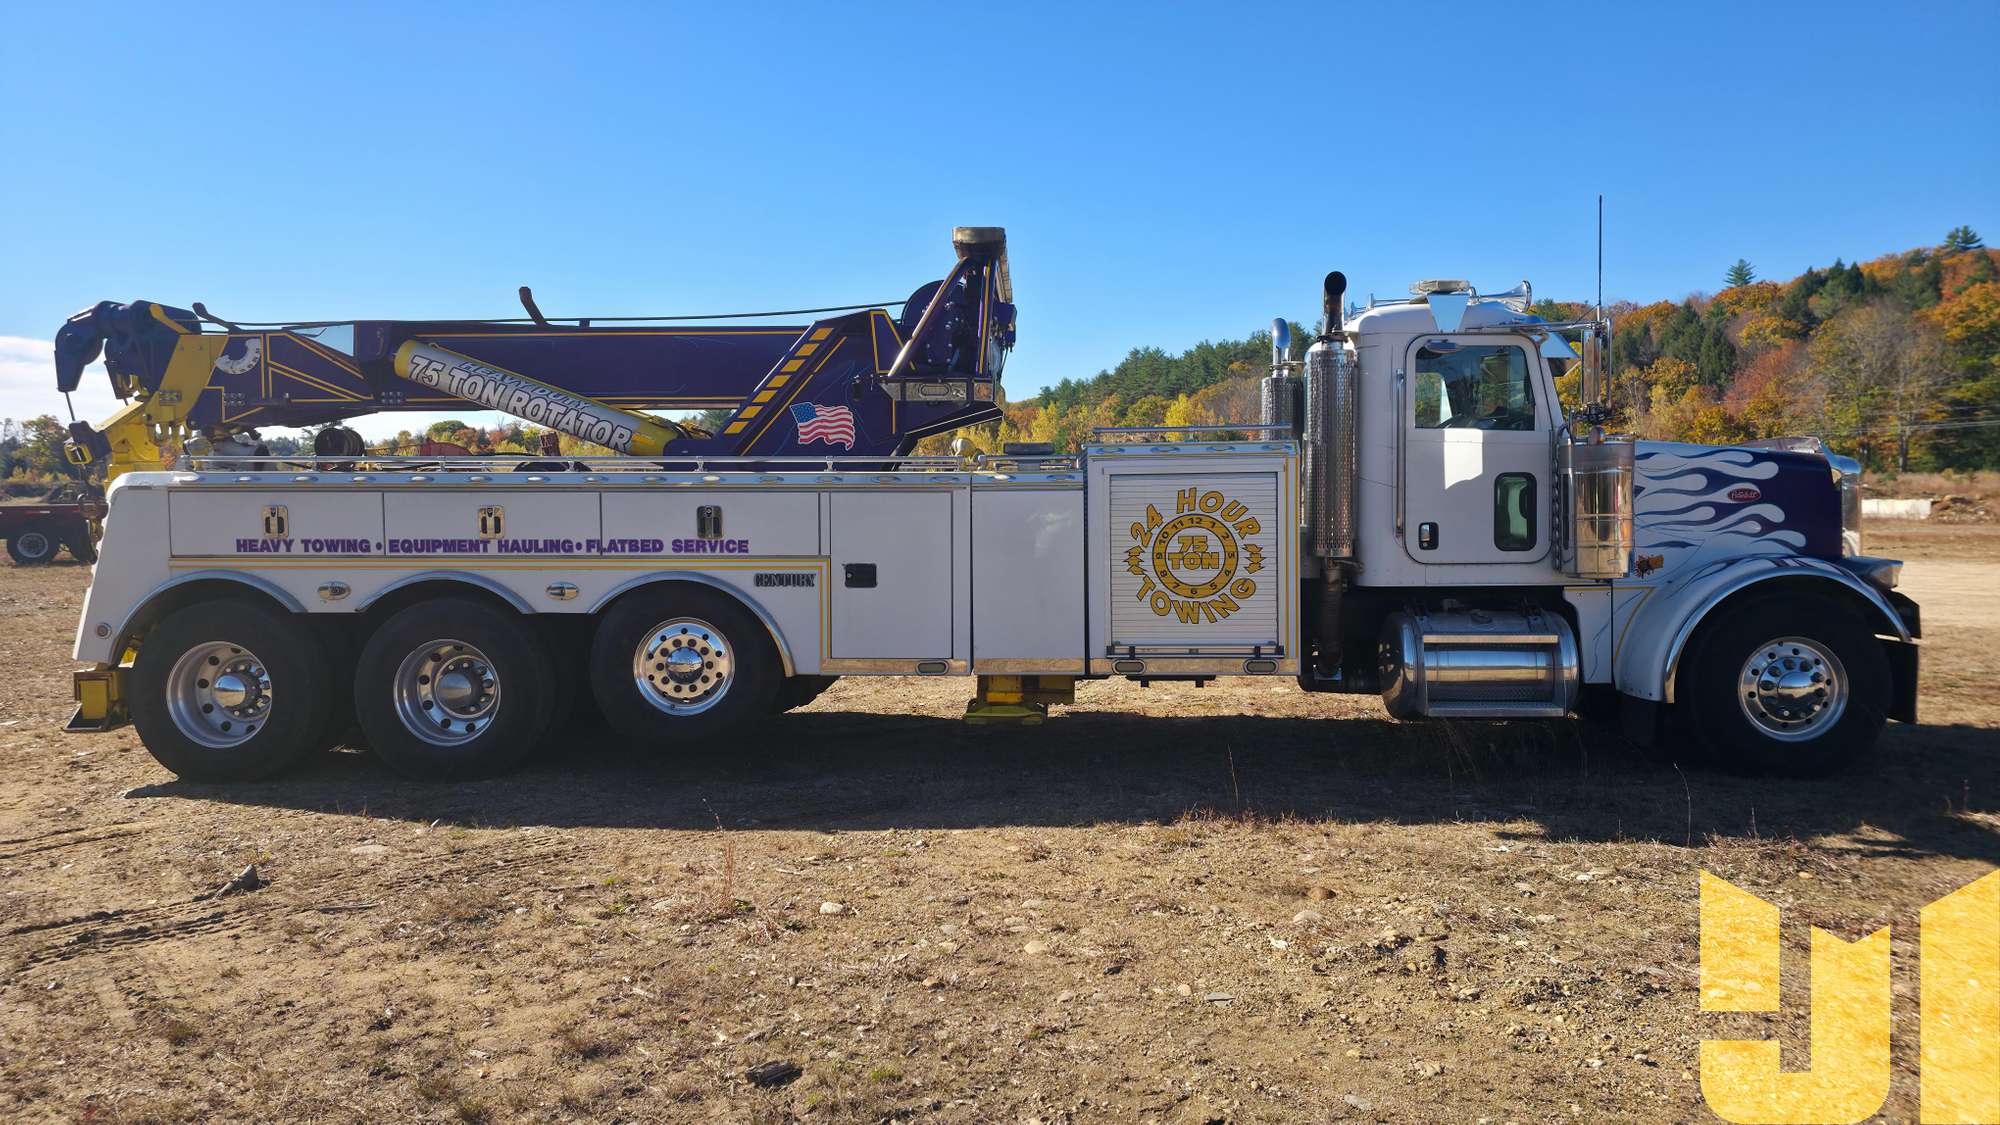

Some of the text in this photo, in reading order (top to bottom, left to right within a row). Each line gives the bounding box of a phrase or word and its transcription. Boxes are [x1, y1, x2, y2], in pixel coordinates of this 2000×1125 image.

[458, 361, 532, 392] HEAVY
[409, 354, 634, 452] 75 TON ROTATOR
[1130, 487, 1261, 548] 24 HOUR
[1171, 520, 1184, 530] 11
[1187, 517, 1203, 525] 12
[236, 539, 749, 553] HEAVY TOWING EQUIPMENT HAULING FLATBED SERVICE
[1159, 531, 1169, 544] 10
[1178, 535, 1209, 553] 75
[1168, 552, 1220, 570] TON
[754, 573, 816, 587] CENTURY
[1136, 573, 1256, 625] TOWING
